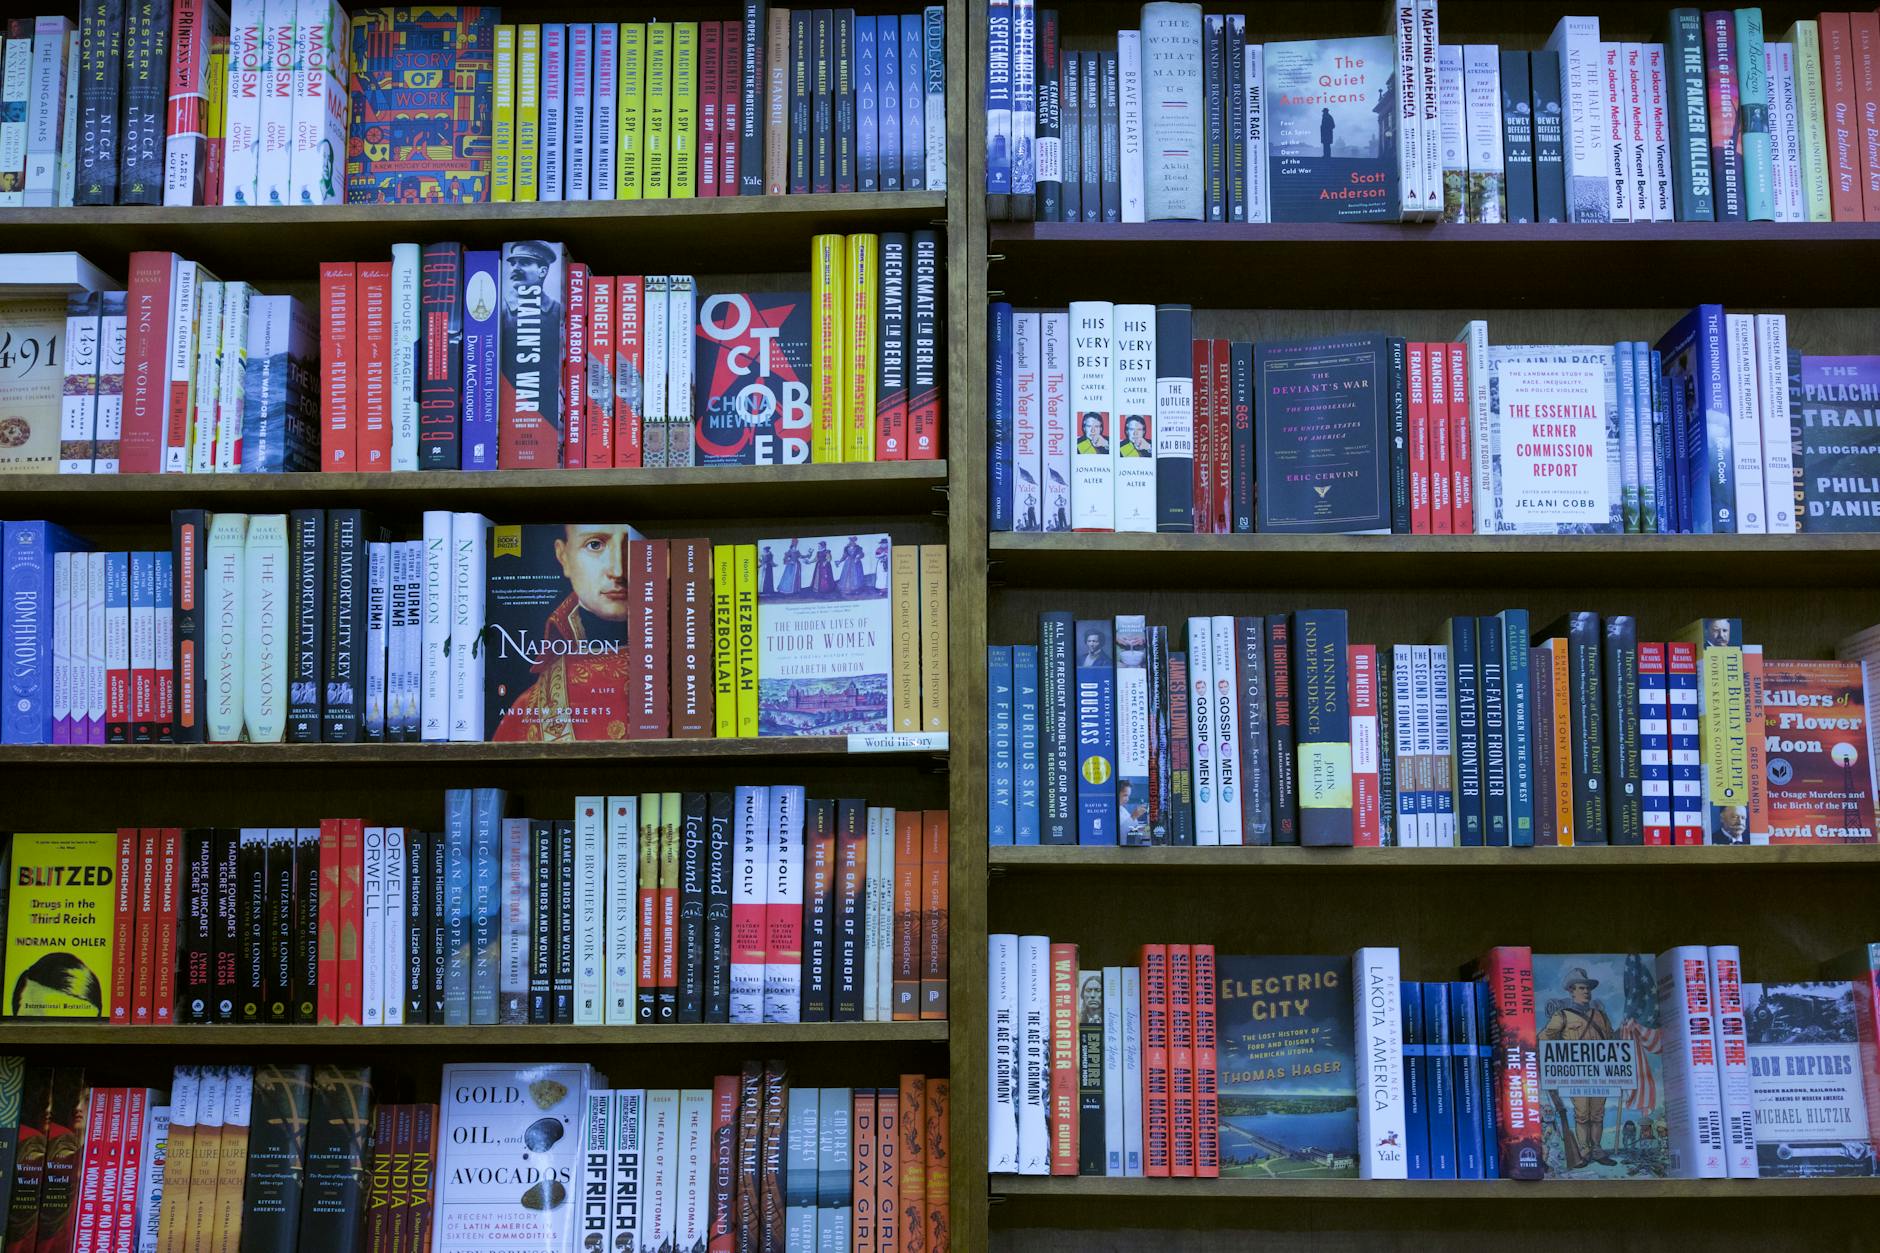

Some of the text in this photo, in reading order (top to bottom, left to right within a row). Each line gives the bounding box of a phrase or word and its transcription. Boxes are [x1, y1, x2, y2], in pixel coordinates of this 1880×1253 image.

[1158, 19, 1190, 28] THE
[96, 4, 106, 81] WESTERN
[929, 10, 941, 92] MUDLARK
[990, 17, 1007, 99] SEPTEMBER 11
[243, 26, 256, 98] MAOISM
[1154, 68, 1196, 77] MADE
[1335, 57, 1364, 69] The
[1318, 74, 1365, 88] Quiet
[746, 87, 754, 137] PROTESTANTS
[1250, 86, 1259, 141] WHITE RAGE
[1280, 91, 1365, 105] Americans
[100, 114, 110, 160] NICK
[1607, 50, 1625, 209] The Jakarta Method Vincent Bevins
[1684, 46, 1710, 196] THE PANZER KILLERS
[84, 108, 95, 168] LLOYD
[744, 176, 762, 185] Yale
[1320, 187, 1385, 200] Anderson
[1351, 172, 1385, 184] Scott
[569, 270, 582, 364] PEARL HARBOR
[595, 283, 608, 346] MENGELE
[885, 244, 902, 388] CHECKMATE IN BERLIN
[1082, 318, 1104, 329] HIS
[516, 285, 541, 413] STALIN'S WAR
[1077, 337, 1110, 349] VERY
[1078, 356, 1109, 368] BEST
[1709, 315, 1722, 409] THE BURNING BLUE
[1273, 380, 1369, 395] DEVIANT'S WAR
[1018, 373, 1034, 455] The Year of Peril
[1510, 404, 1596, 418] THE ESSENTIAL
[1533, 424, 1576, 438] KERNER
[1517, 444, 1593, 457] COMMISSION
[1534, 463, 1577, 477] REPORT
[1516, 498, 1595, 508] JELANI COBB
[428, 538, 443, 624] NAPOLEON
[302, 518, 315, 679] THE IMMORTALITY KEY
[408, 584, 420, 625] BURMA
[14, 592, 37, 678] ROMANOVS
[221, 553, 234, 716] THE ANGLO-SAXONS
[491, 624, 618, 664] NAPOLEON
[645, 581, 654, 714] THE ALLURE OF BATTLE
[718, 594, 731, 694] HEZBOLLAH
[767, 631, 876, 652] TUDOR WOMEN
[1057, 660, 1066, 707] FREQUENT
[1306, 621, 1320, 735] INDEPENDENCE
[1324, 643, 1335, 712] WINNING
[557, 708, 612, 716] ROBERTS
[1081, 683, 1098, 745] DOUGLASS
[1836, 693, 1850, 707] of
[1058, 711, 1066, 757] TROUBLES
[1458, 664, 1478, 796] ILL-FATED FRONTIER
[1780, 713, 1861, 730] Flower
[865, 737, 893, 747] World
[1059, 774, 1067, 792] OUR
[1313, 753, 1322, 800] FERLING
[1325, 762, 1334, 790] JOHN
[1781, 790, 1864, 800] Osage Murders and
[1815, 825, 1871, 837] Grann
[686, 816, 703, 893] Icebound
[19, 866, 112, 886] BLITZED
[120, 858, 130, 912] BOHEMIANS
[367, 833, 380, 916] ORWELL
[744, 859, 753, 895] FOLLY
[32, 899, 94, 910] Drugs in the
[412, 876, 420, 917] Histories
[32, 914, 95, 925] Third Reich
[16, 937, 106, 946] NORMAN OHLER
[1055, 960, 1071, 995] WAR
[1222, 971, 1339, 1000] ELECTRIC
[1253, 1000, 1309, 1021] CITY
[1056, 1010, 1071, 1070] BORDER
[1278, 1029, 1308, 1038] HISTORY
[1370, 966, 1388, 1111] LAKOTA AMERICA
[1249, 1052, 1284, 1060] AMERICAN
[1544, 1042, 1631, 1062] AMERICA'S
[1785, 1055, 1851, 1075] EMPIRES
[1223, 1061, 1342, 1084] THOMAS HAGER
[1545, 1064, 1632, 1077] FORGOTTEN WARS
[456, 1086, 525, 1104] GOLD,
[1507, 1046, 1524, 1128] THE MISSION
[1526, 1052, 1540, 1122] MURDER AT
[1755, 1108, 1851, 1124] MICHAEL HILTZIK
[453, 1126, 522, 1145] OIL, and
[1377, 1150, 1400, 1161] Yale
[372, 1154, 388, 1208] INDIA
[451, 1167, 571, 1185] AVOCADOS
[585, 1155, 607, 1230] AFRICA
